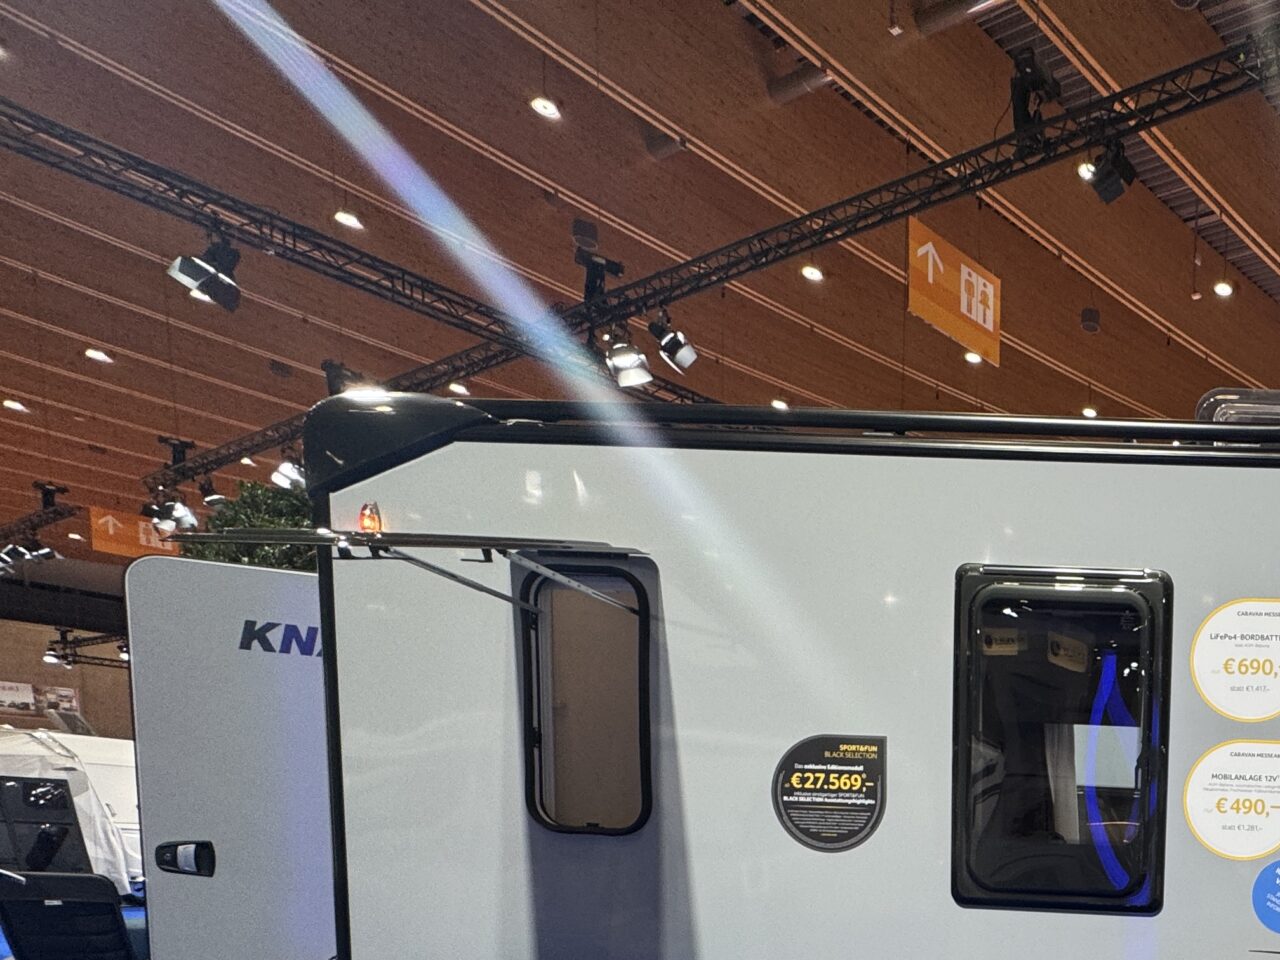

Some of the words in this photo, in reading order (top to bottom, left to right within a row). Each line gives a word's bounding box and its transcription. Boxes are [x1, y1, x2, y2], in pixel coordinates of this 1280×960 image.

[1237, 610, 1263, 618] CARAVAN
[239, 620, 323, 657] KN
[839, 744, 878, 752] SPORT&FUN
[1211, 773, 1263, 782] MOBILANLAGE
